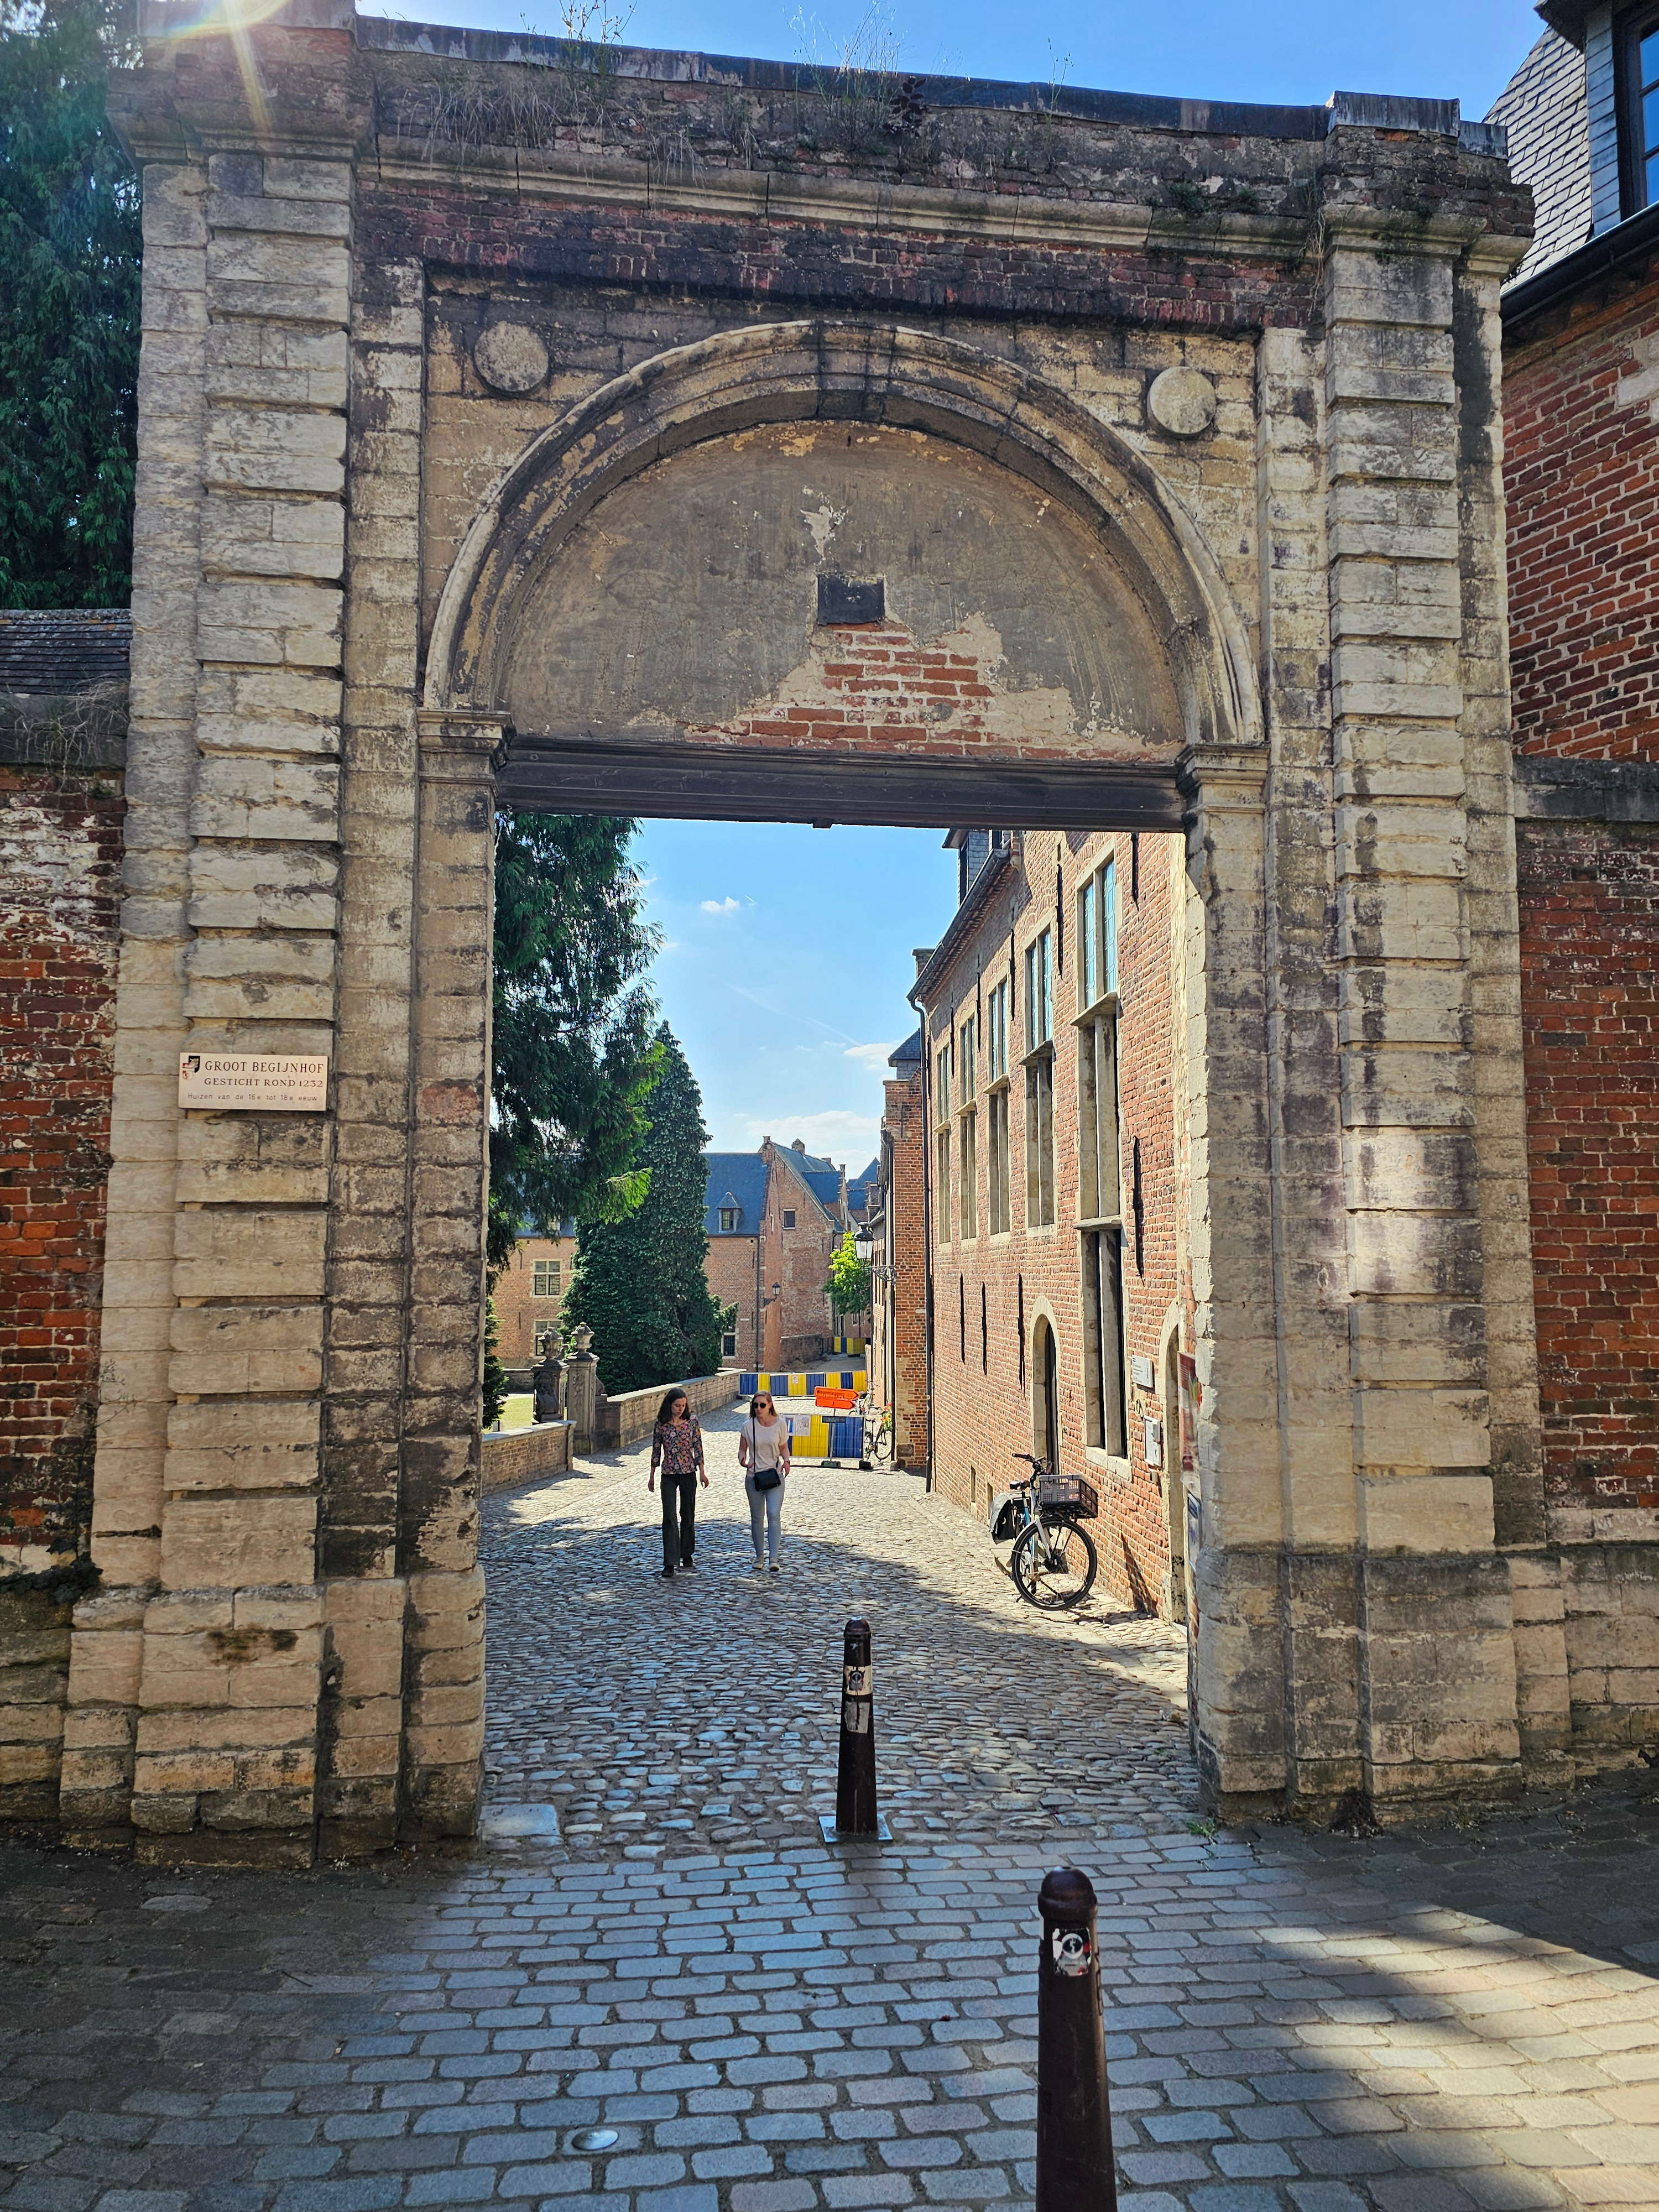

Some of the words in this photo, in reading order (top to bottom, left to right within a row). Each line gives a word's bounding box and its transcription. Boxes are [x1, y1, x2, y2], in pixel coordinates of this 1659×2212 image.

[205, 1061, 247, 1071] GROOT
[252, 1062, 324, 1073] BEGIJNHOF
[204, 1078, 260, 1086] GESTICHT
